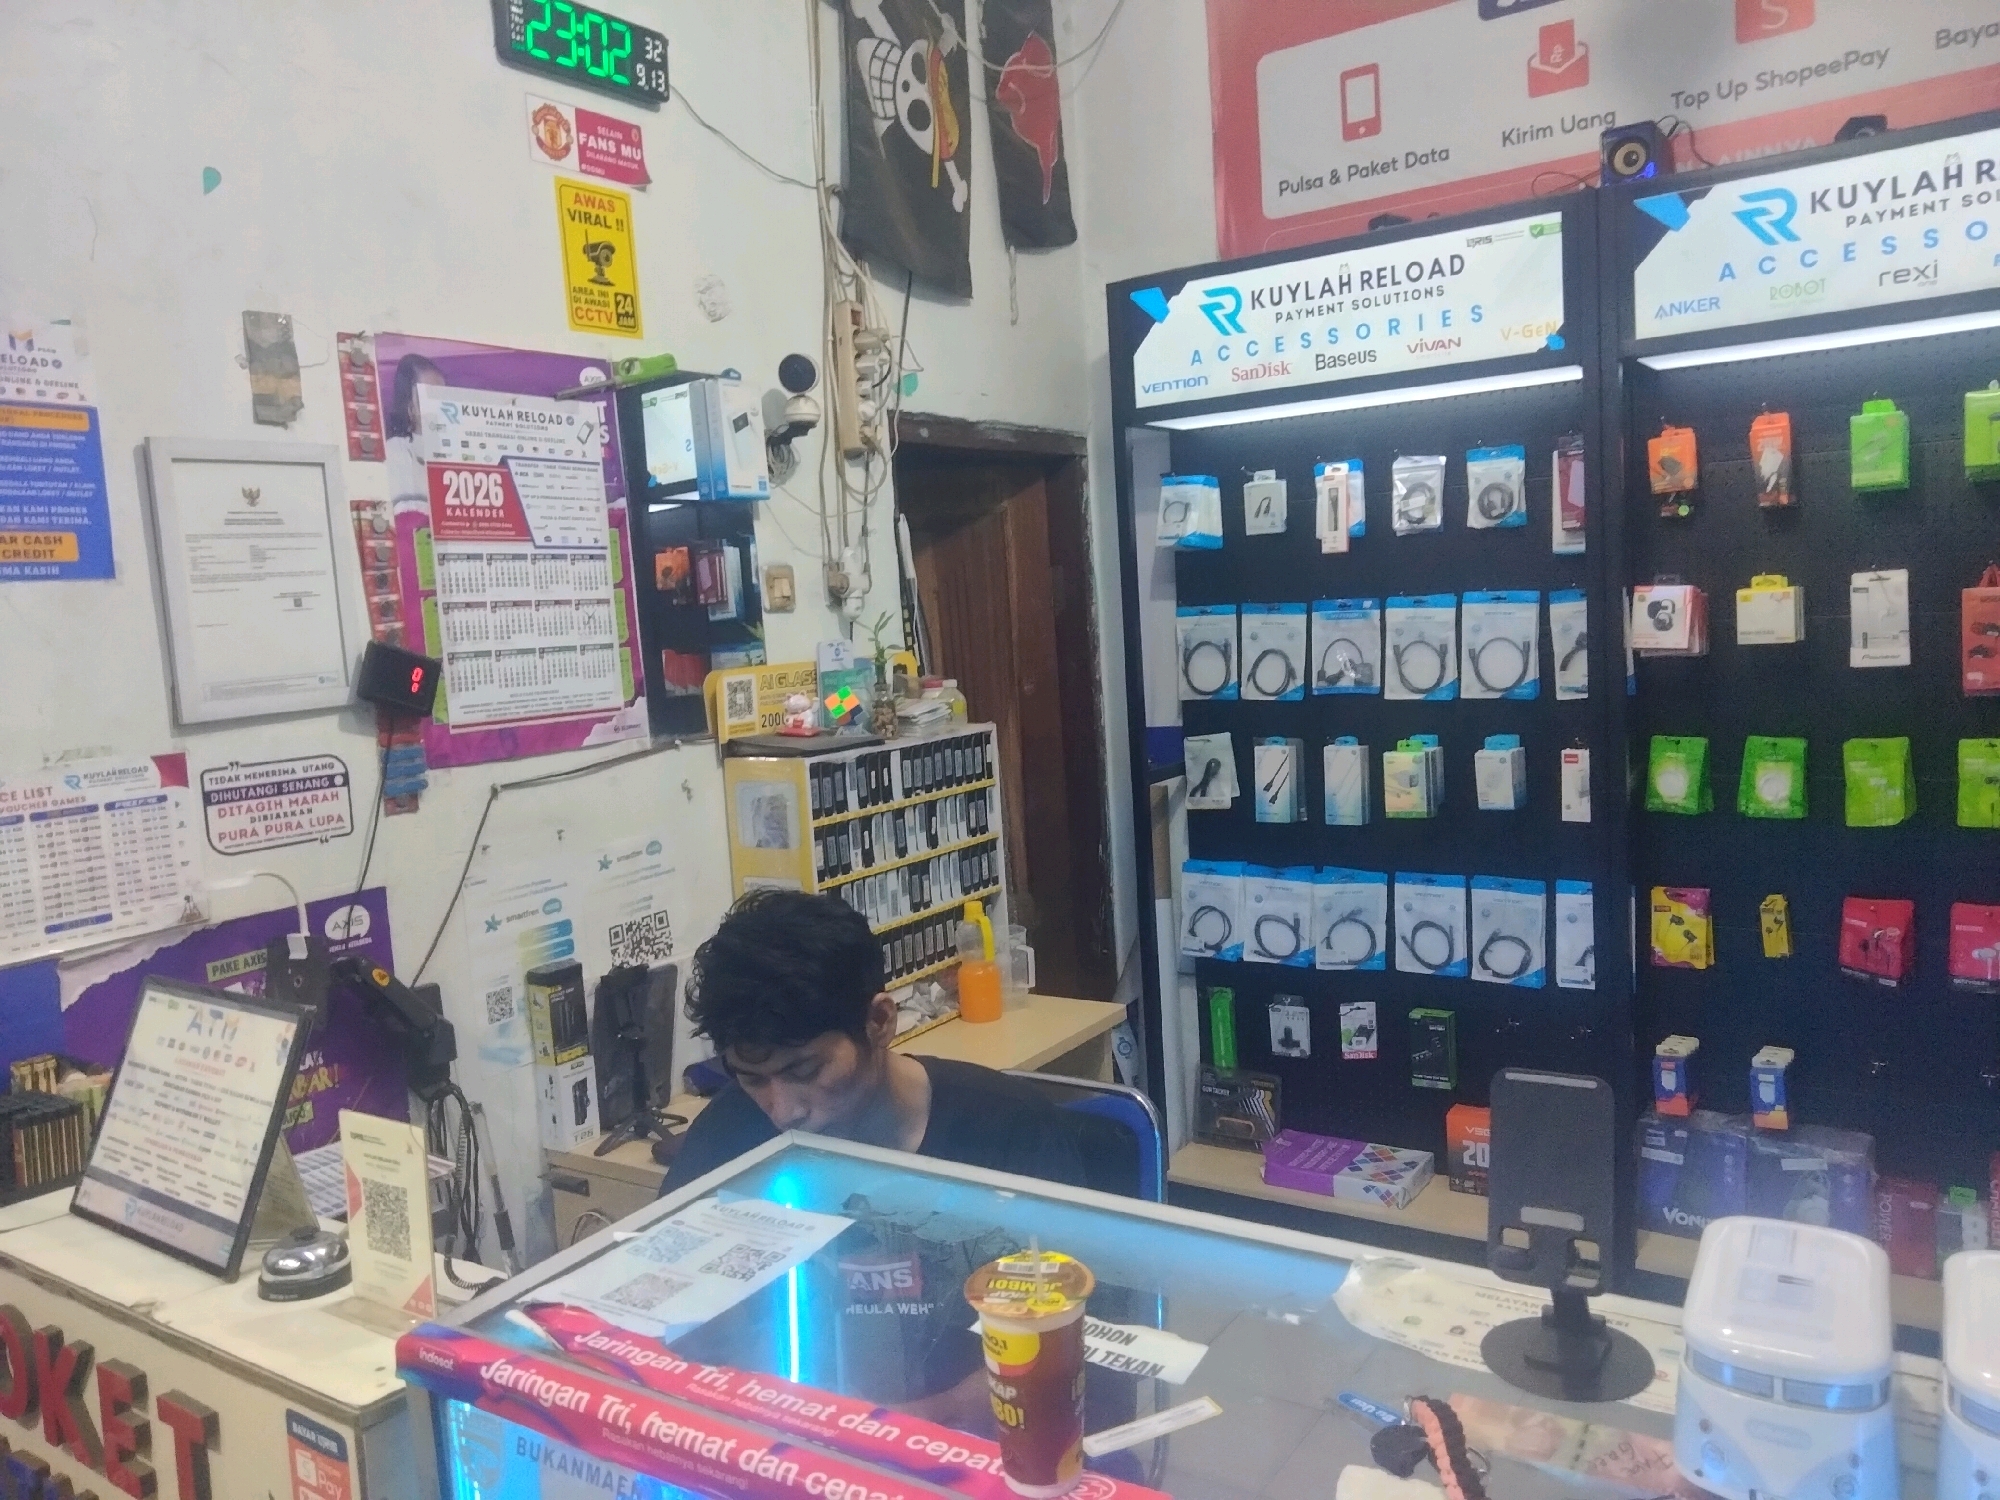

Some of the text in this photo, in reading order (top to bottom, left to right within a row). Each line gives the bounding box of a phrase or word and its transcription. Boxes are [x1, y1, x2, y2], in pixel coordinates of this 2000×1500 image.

[526, 0, 631, 86] 23:02
[645, 37, 663, 62] 32
[1672, 48, 1891, 114] Top Up ShopeePay
[1502, 110, 1617, 147] Kirim Uang
[579, 132, 642, 161] FANS MU
[1279, 148, 1450, 197] Pulsa & Paket Data
[1811, 163, 1963, 214] KUYLAH
[573, 192, 616, 213] AWAS
[1846, 198, 1950, 228] PAYMENT
[567, 208, 624, 232] VIRAL !!
[1250, 253, 1466, 311] KUYLAH RELOAD
[1879, 259, 1939, 287] rexi
[572, 286, 610, 299] AREA INI
[1770, 278, 1827, 301] ROBOT
[584, 297, 611, 309] AWASI
[616, 295, 633, 314] 24
[1274, 284, 1446, 324] PAYMENT SOLUTIONS
[1654, 296, 1722, 320] ANKER
[574, 307, 613, 325] CCTV
[618, 315, 635, 326] JAM
[1190, 304, 1484, 366] ACCESSORIES
[1231, 361, 1293, 383] SanDisk
[1315, 349, 1378, 371] Baseus
[1141, 375, 1209, 395] VENTION
[461, 404, 563, 426] KUYLAH RELOAD
[442, 470, 504, 507] 2026
[446, 508, 504, 519] KALENDER
[23, 535, 63, 545] CASH
[2, 549, 56, 559] CREDIT
[24, 566, 60, 575] KASIH
[760, 673, 774, 691] AI
[761, 712, 786, 729] 200
[209, 761, 335, 786] TIDAK MENERIMA UTANG
[24, 786, 53, 801] LIST
[51, 795, 87, 807] GAMES
[210, 777, 330, 803] DIHUTANGI SENANG
[217, 790, 339, 819] DITAGIH MARAH
[250, 807, 313, 824] DIBIARKAN
[217, 828, 259, 843] PURA
[265, 820, 303, 835] PURA
[309, 813, 345, 828] LUPA
[332, 914, 364, 932] AXIS
[506, 907, 540, 924] smartfren
[211, 951, 267, 977] PAKE AXIS
[1343, 1051, 1375, 1060] SanDisk
[711, 1203, 760, 1221] KUYLAH
[1084, 1320, 1138, 1346] OHON
[1100, 1350, 1166, 1377] TEKAN
[574, 1329, 691, 1376] Jaringan
[694, 1363, 730, 1394] Tri,
[738, 1378, 839, 1422] hemat
[838, 1409, 902, 1442] dan
[686, 1382, 839, 1438] Rasakan hebatnya sekarang!
[480, 1358, 799, 1488] Jaringan Tri, hemat dan
[696, 1457, 750, 1490] sekarang!
